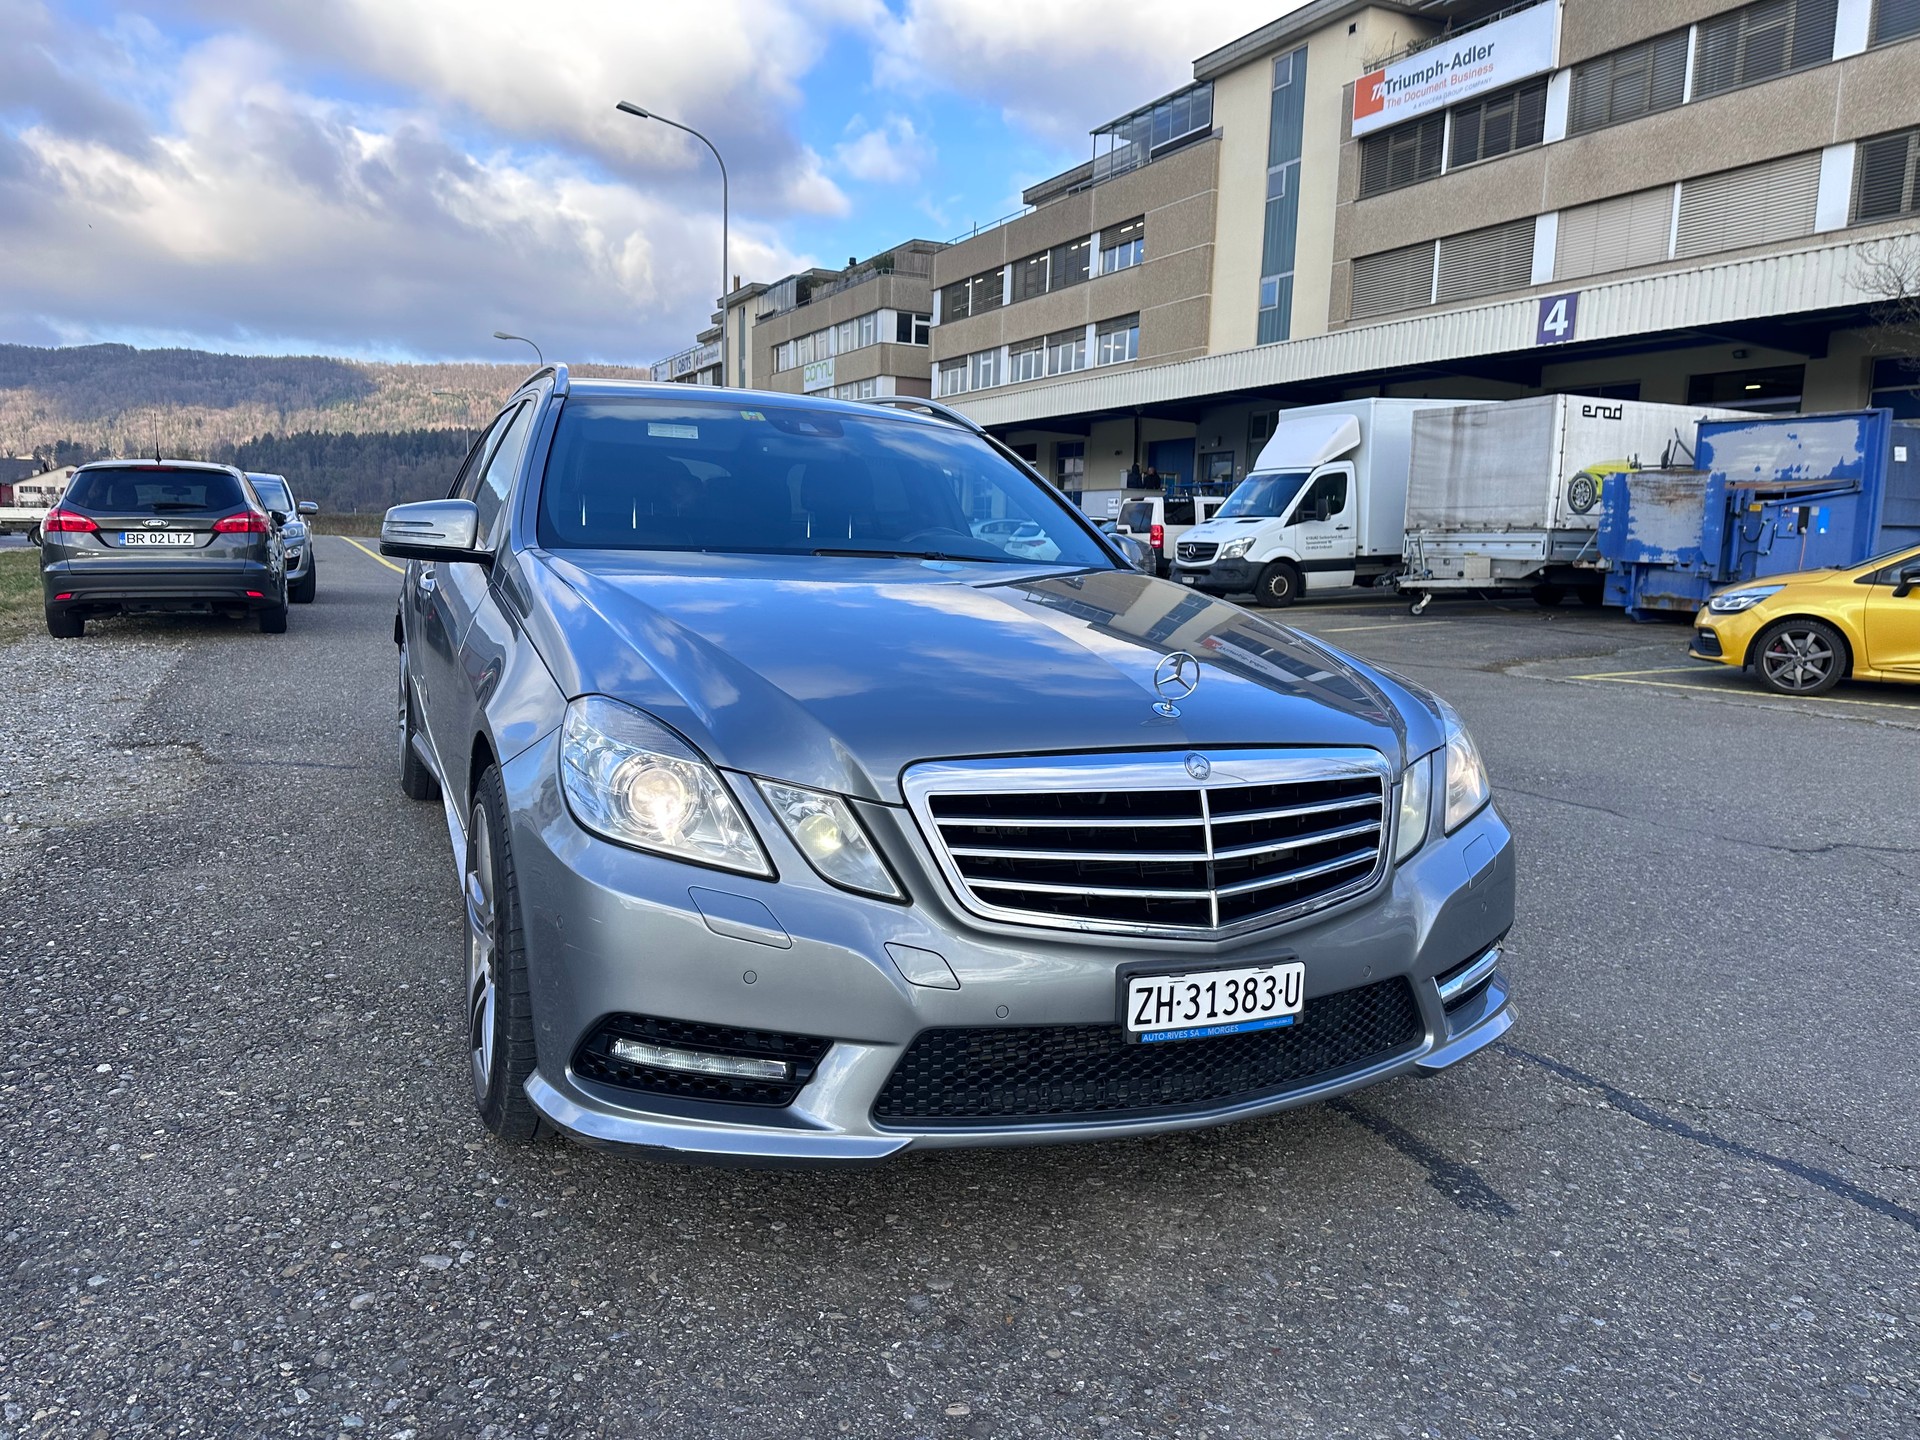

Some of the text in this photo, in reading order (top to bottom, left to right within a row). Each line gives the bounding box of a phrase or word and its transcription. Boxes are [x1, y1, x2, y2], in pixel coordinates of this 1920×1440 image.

[1385, 42, 1495, 95] Triumph-Adler
[1387, 63, 1494, 110] The Document Business
[1543, 298, 1569, 337] 4
[126, 533, 145, 544] BR
[149, 533, 165, 544] 02
[167, 533, 192, 544] LTZ
[1142, 1030, 1188, 1042] AUTO-RIVES
[1189, 1029, 1200, 1037] SA
[1207, 1024, 1239, 1035] MORGES
